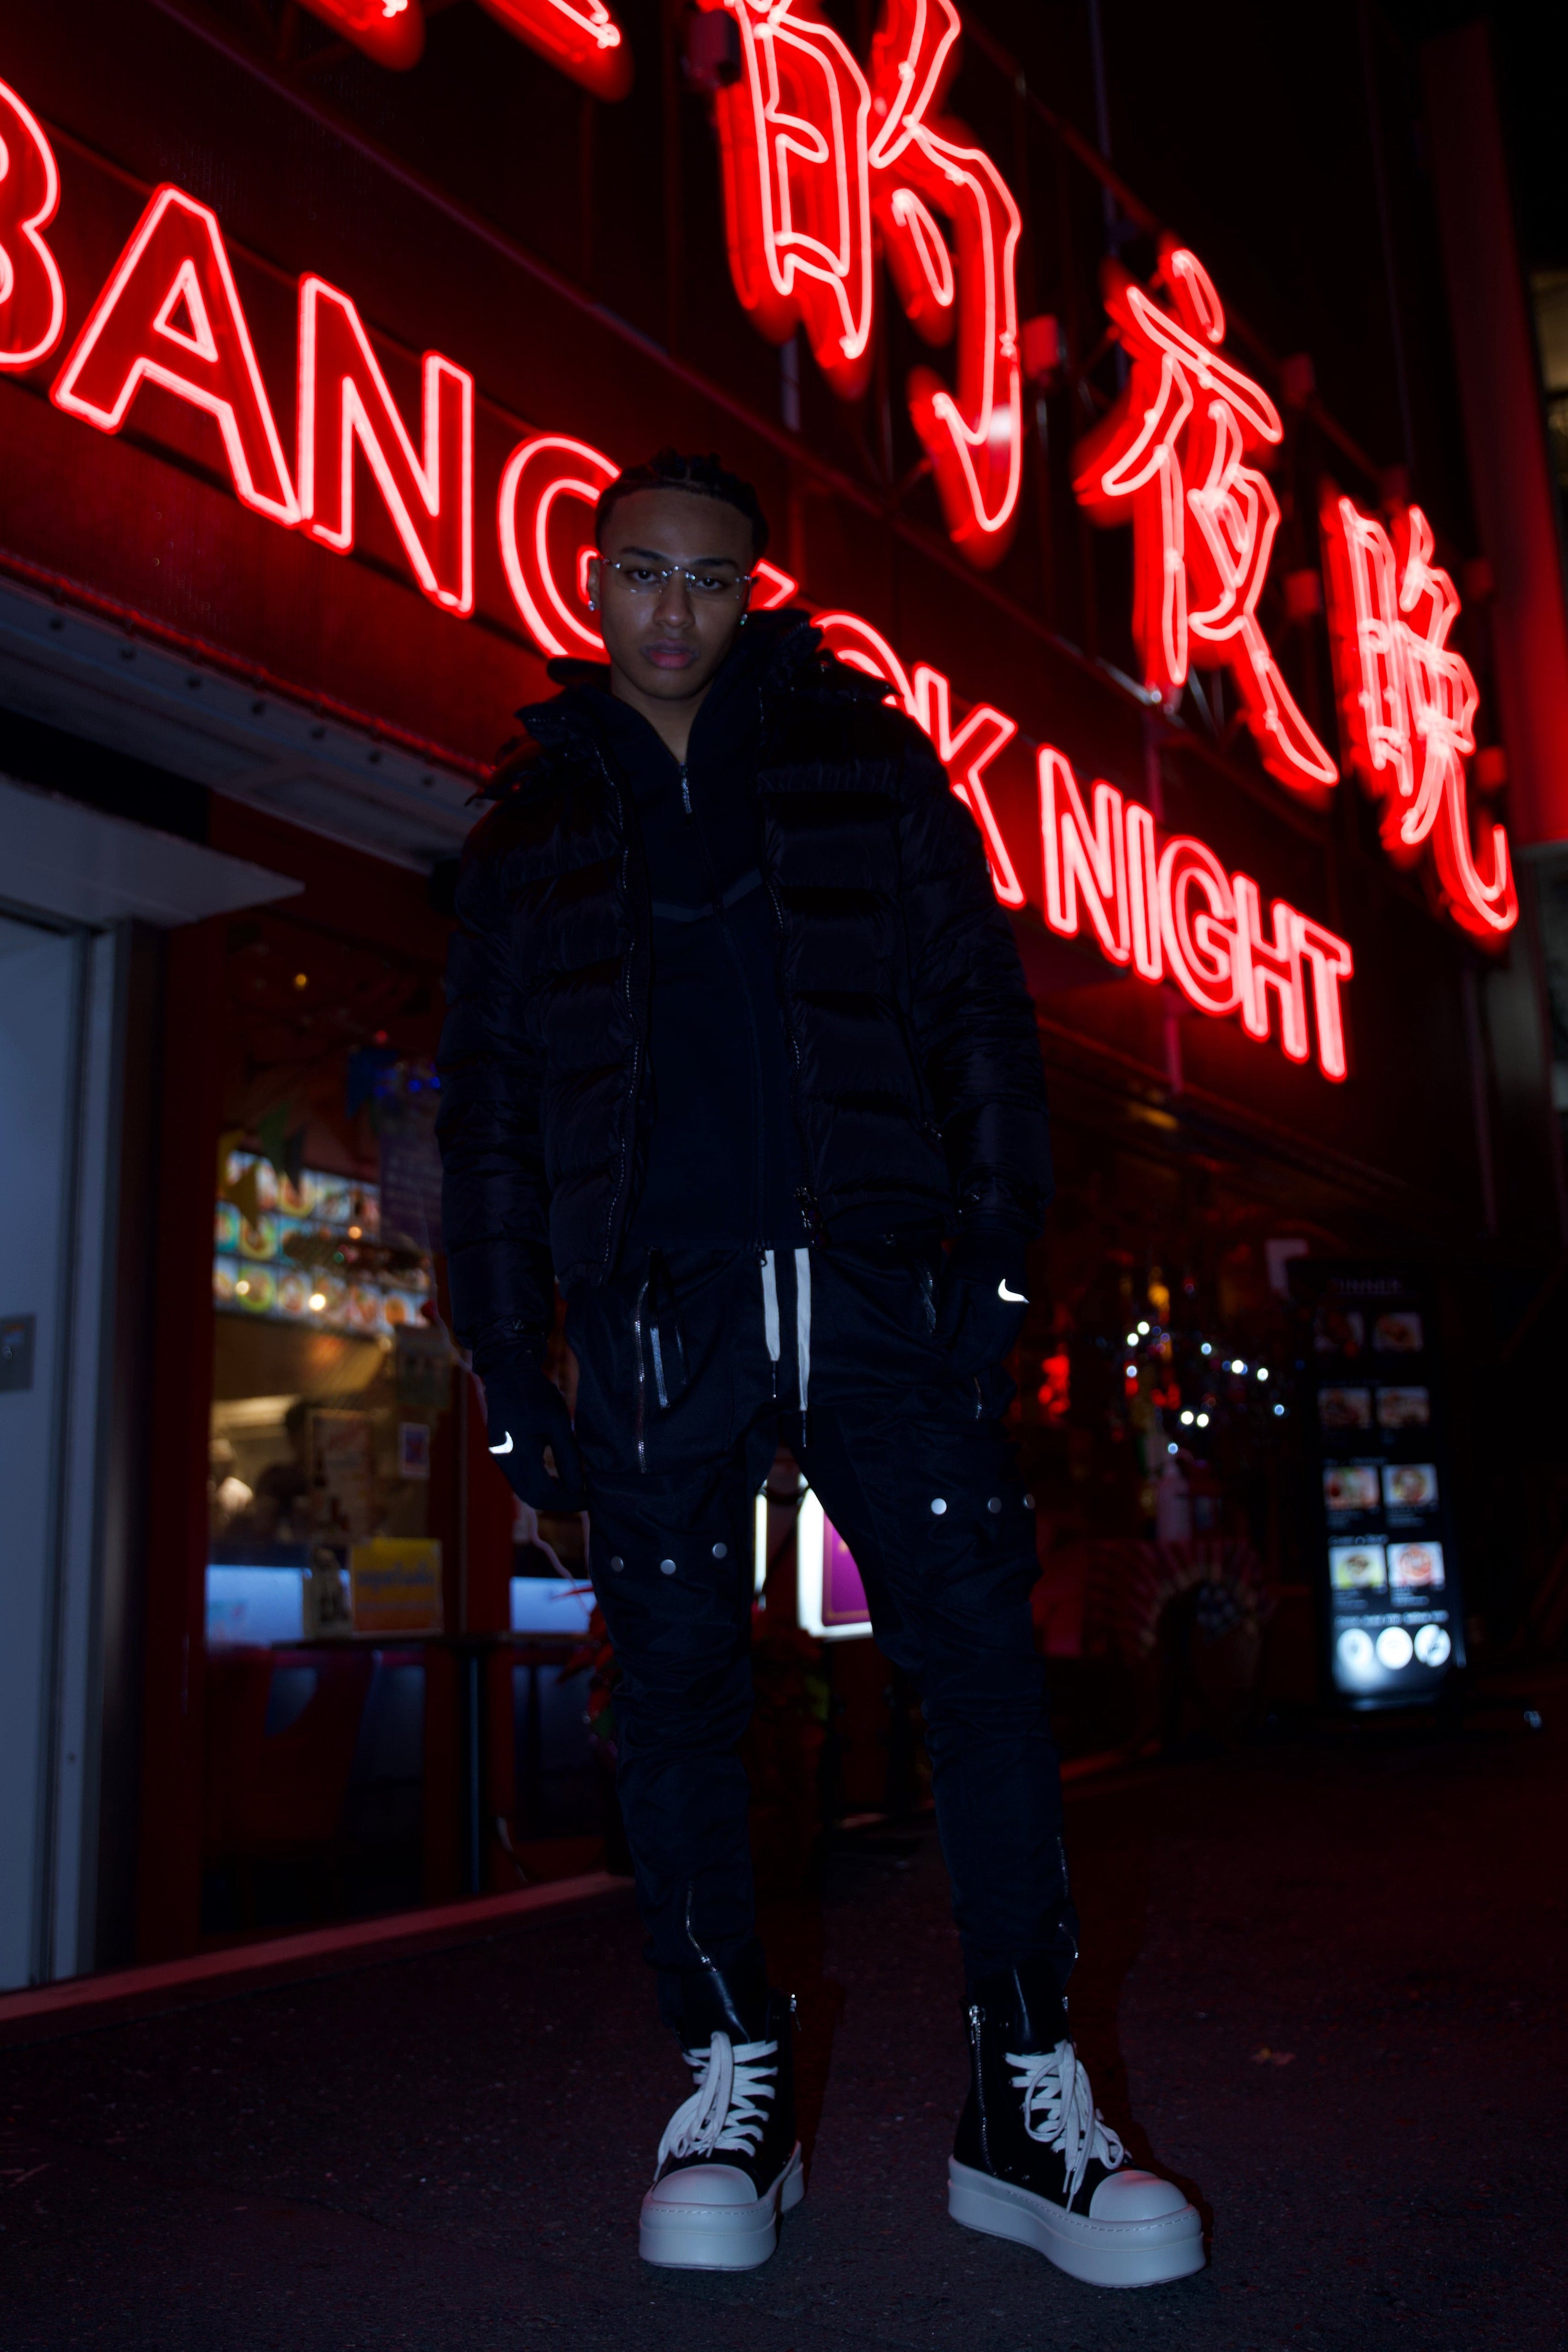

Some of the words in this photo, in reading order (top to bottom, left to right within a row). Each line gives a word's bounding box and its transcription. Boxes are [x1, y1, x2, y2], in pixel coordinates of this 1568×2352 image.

[369, 0, 1521, 932] 的夜晚
[1038, 744, 1354, 1082] NIGHT
